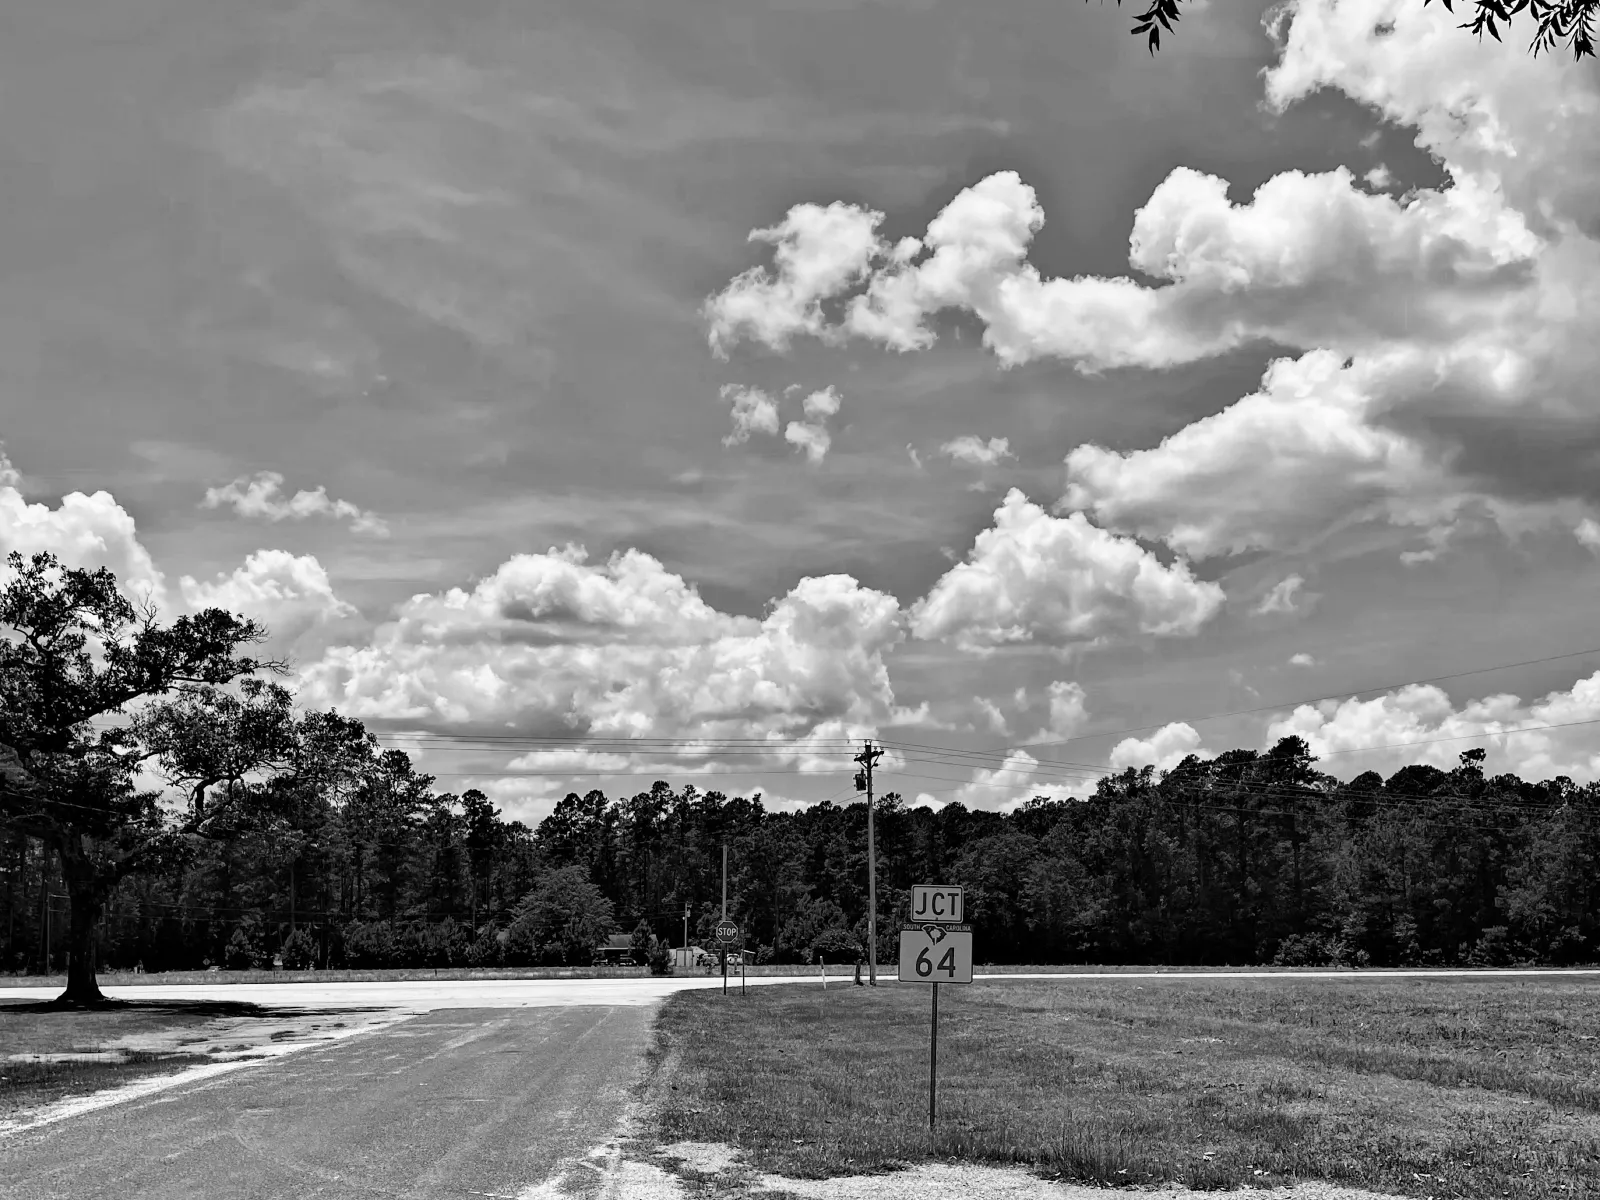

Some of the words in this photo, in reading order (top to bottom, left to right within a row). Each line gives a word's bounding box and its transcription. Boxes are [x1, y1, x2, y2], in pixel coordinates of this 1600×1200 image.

[915, 892, 959, 915] JCT
[718, 928, 736, 936] STOP
[916, 947, 955, 977] 64
